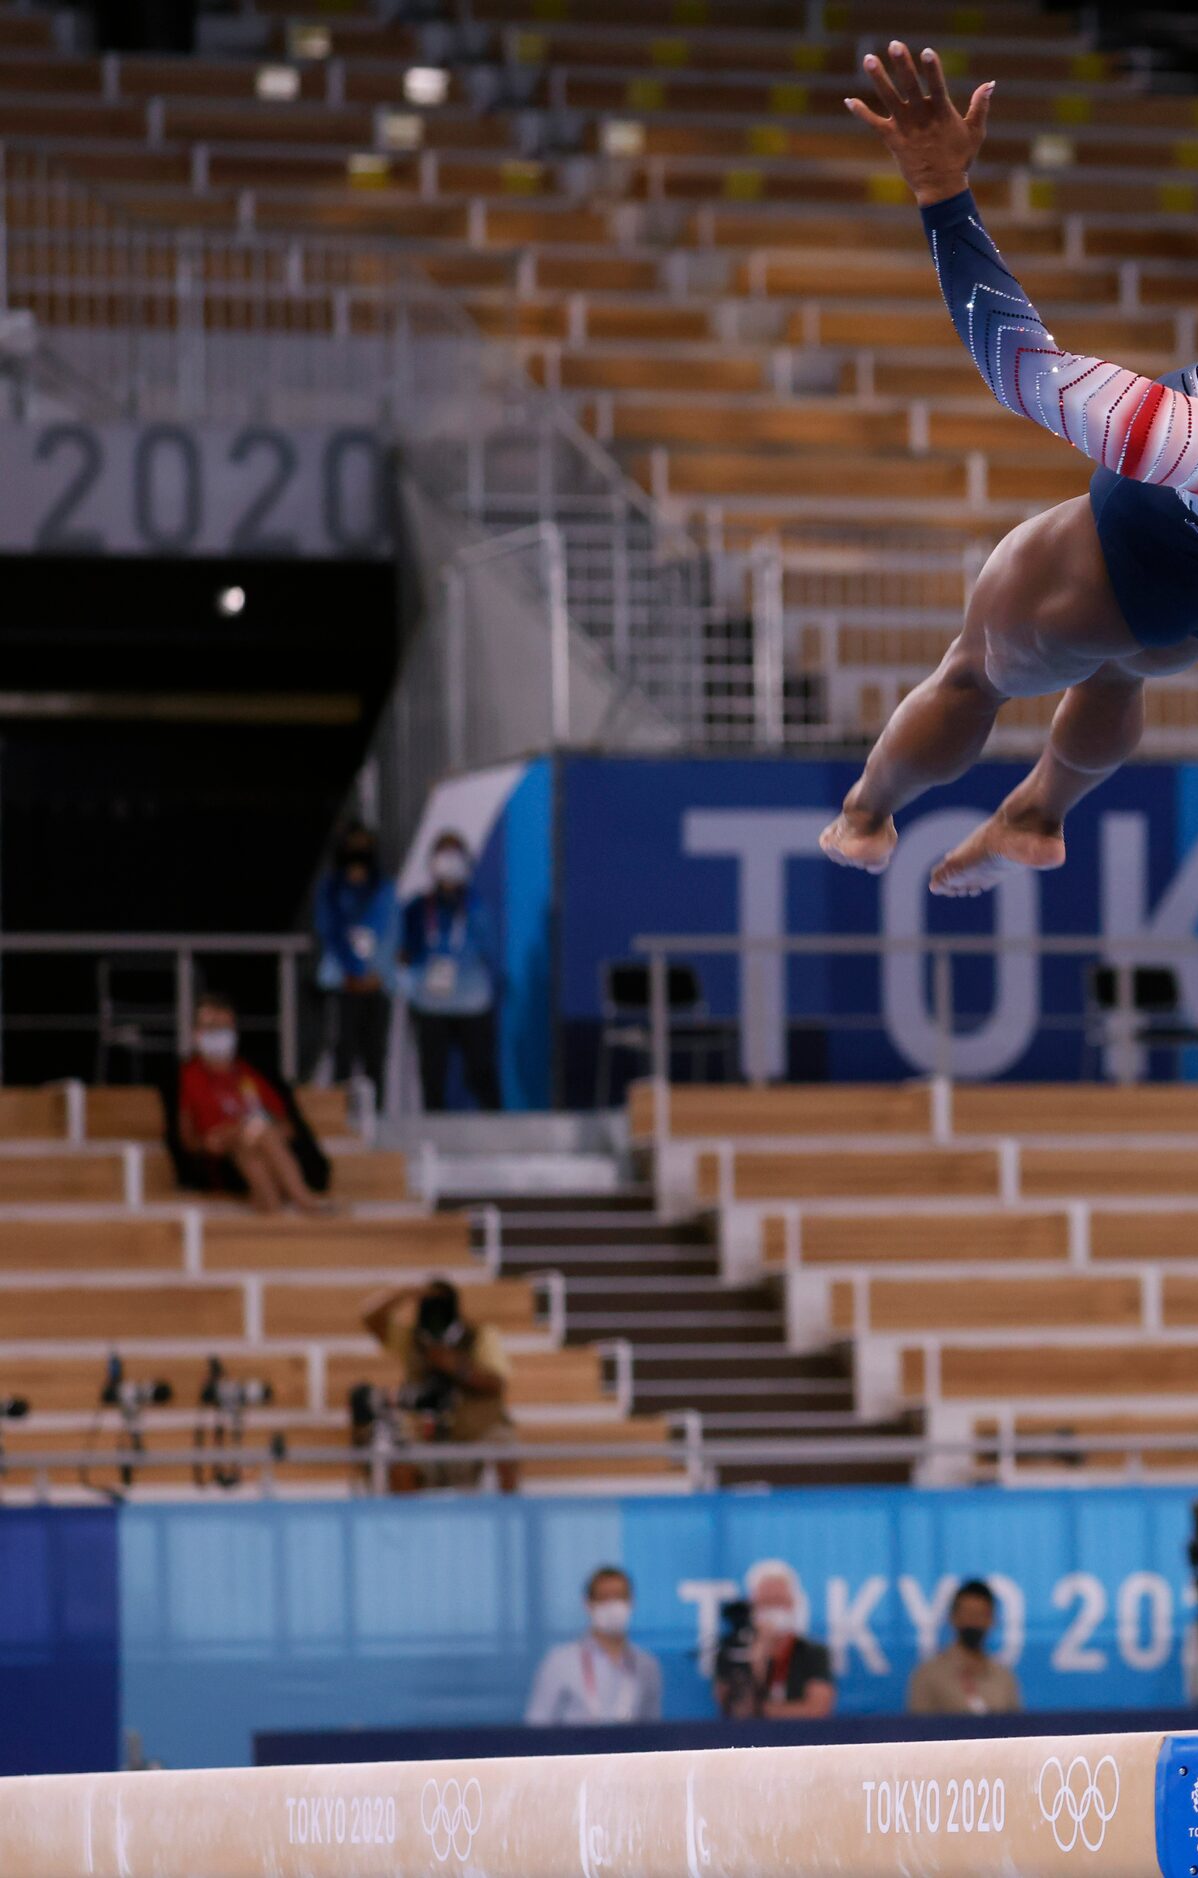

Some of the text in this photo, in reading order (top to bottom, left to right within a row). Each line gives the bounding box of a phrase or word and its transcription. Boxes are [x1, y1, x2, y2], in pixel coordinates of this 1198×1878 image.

[34, 422, 386, 557] 2020
[287, 1796, 395, 1844] TOKYO 2020
[862, 1777, 1006, 1834] TOKYO 2020
